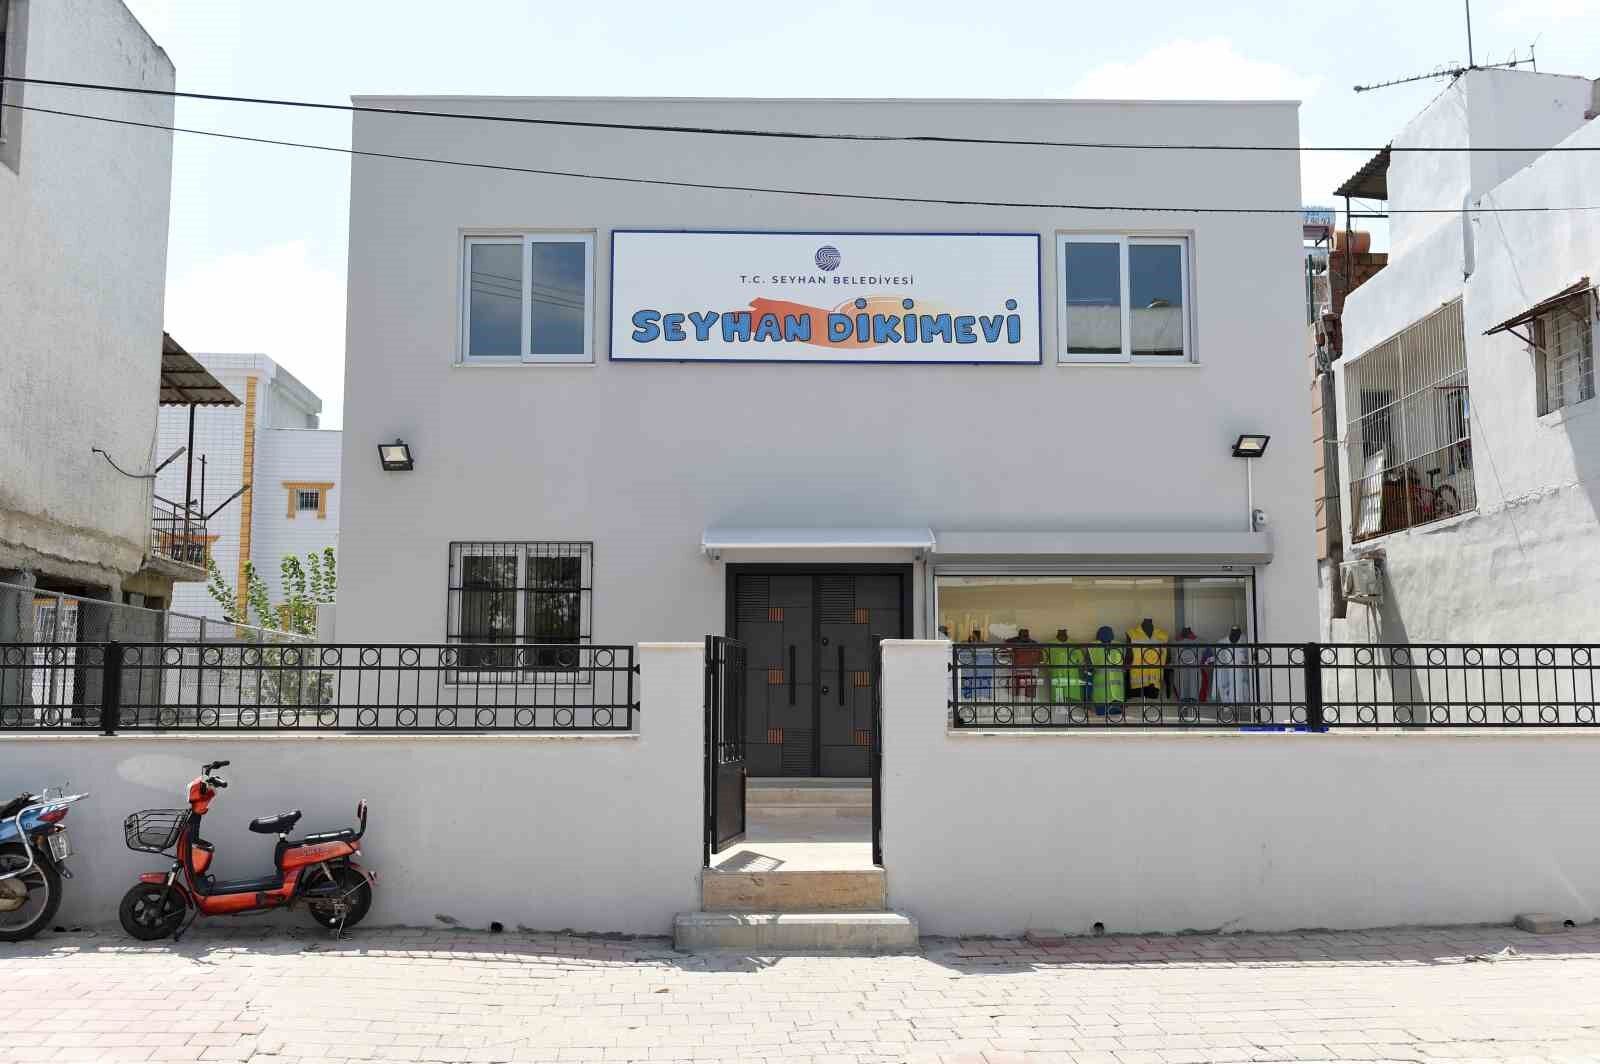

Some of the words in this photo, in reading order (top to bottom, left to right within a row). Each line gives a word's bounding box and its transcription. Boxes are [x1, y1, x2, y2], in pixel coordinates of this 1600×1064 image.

[739, 275, 766, 284] T.C.
[772, 275, 826, 285] SEYHAN
[833, 275, 914, 285] BELEDİYESİ
[631, 309, 811, 343] SEYHAN
[827, 298, 1022, 344] DİKİMEVİ
